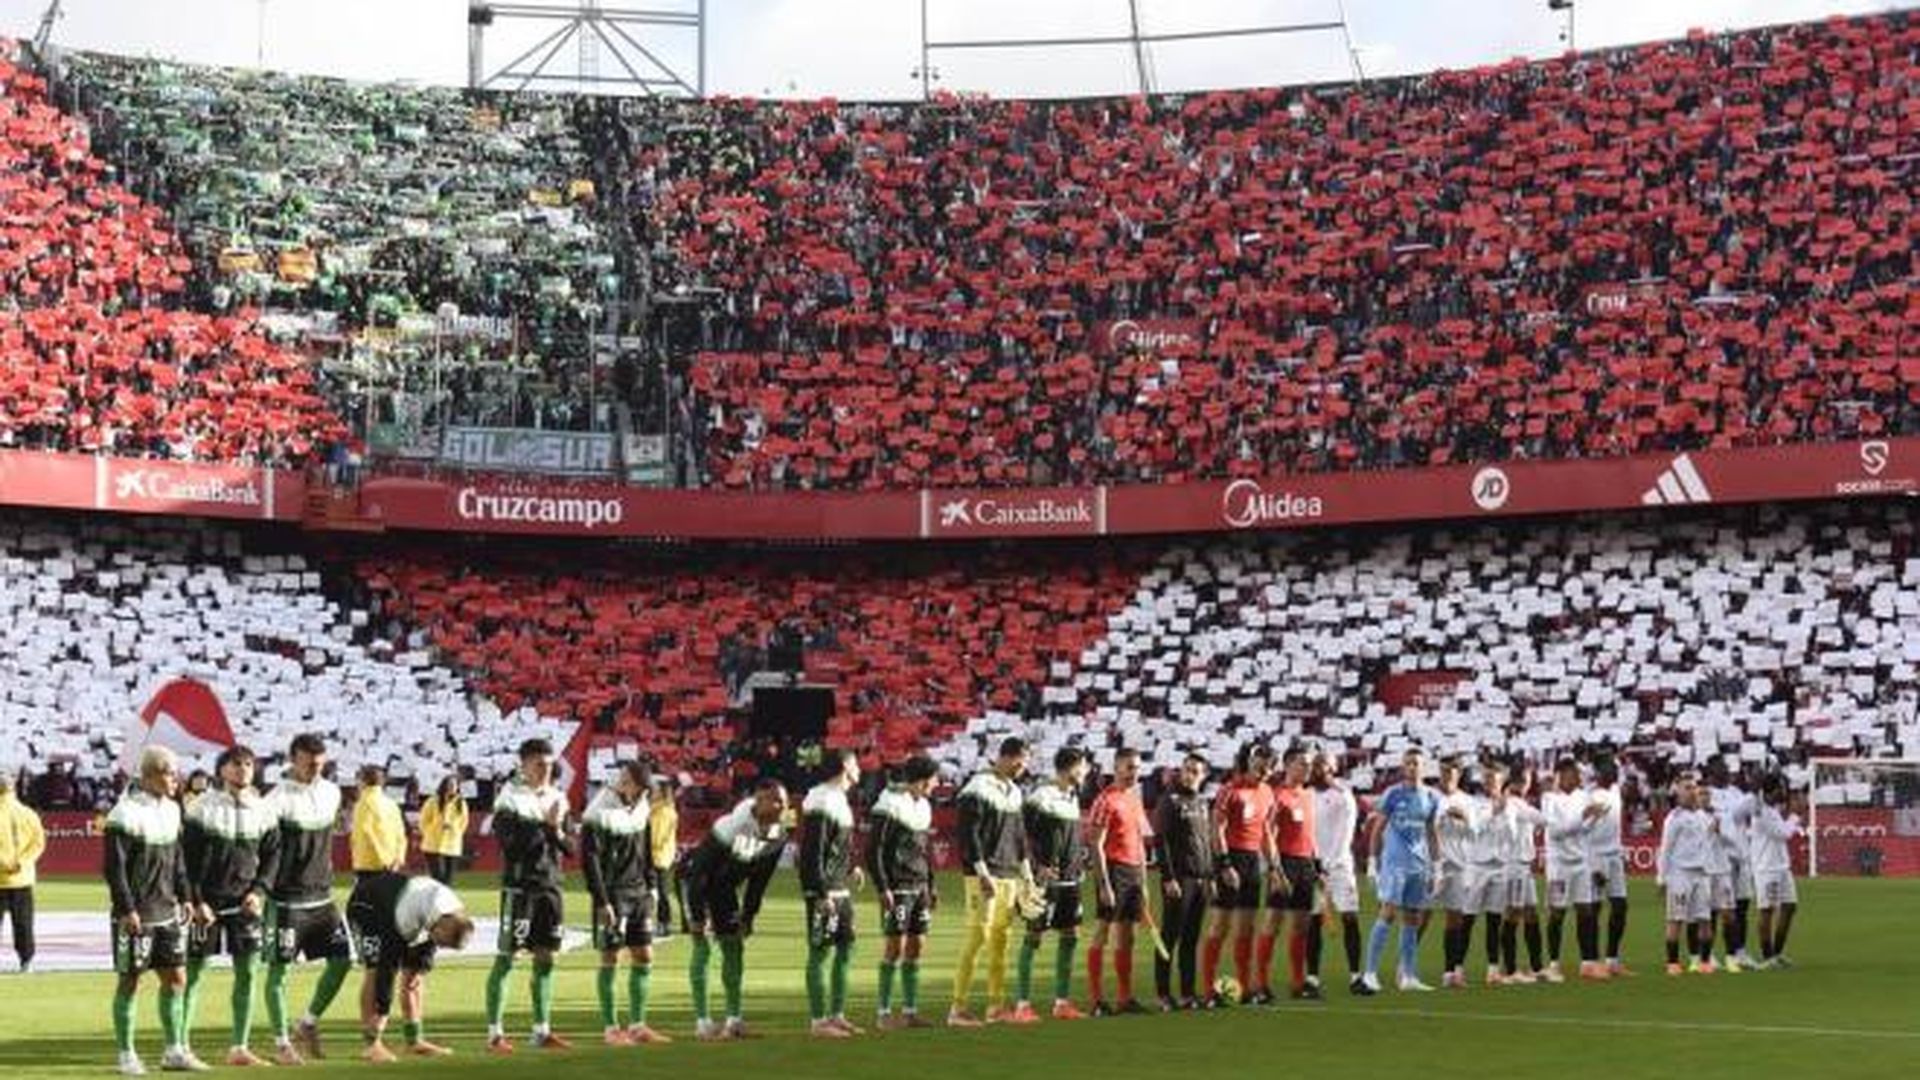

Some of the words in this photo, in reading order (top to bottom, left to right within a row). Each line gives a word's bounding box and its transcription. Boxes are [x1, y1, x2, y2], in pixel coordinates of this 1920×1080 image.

[458, 487, 623, 528] Cruzcampo
[974, 499, 1091, 525] CaixaBank
[1224, 480, 1322, 528] Midea
